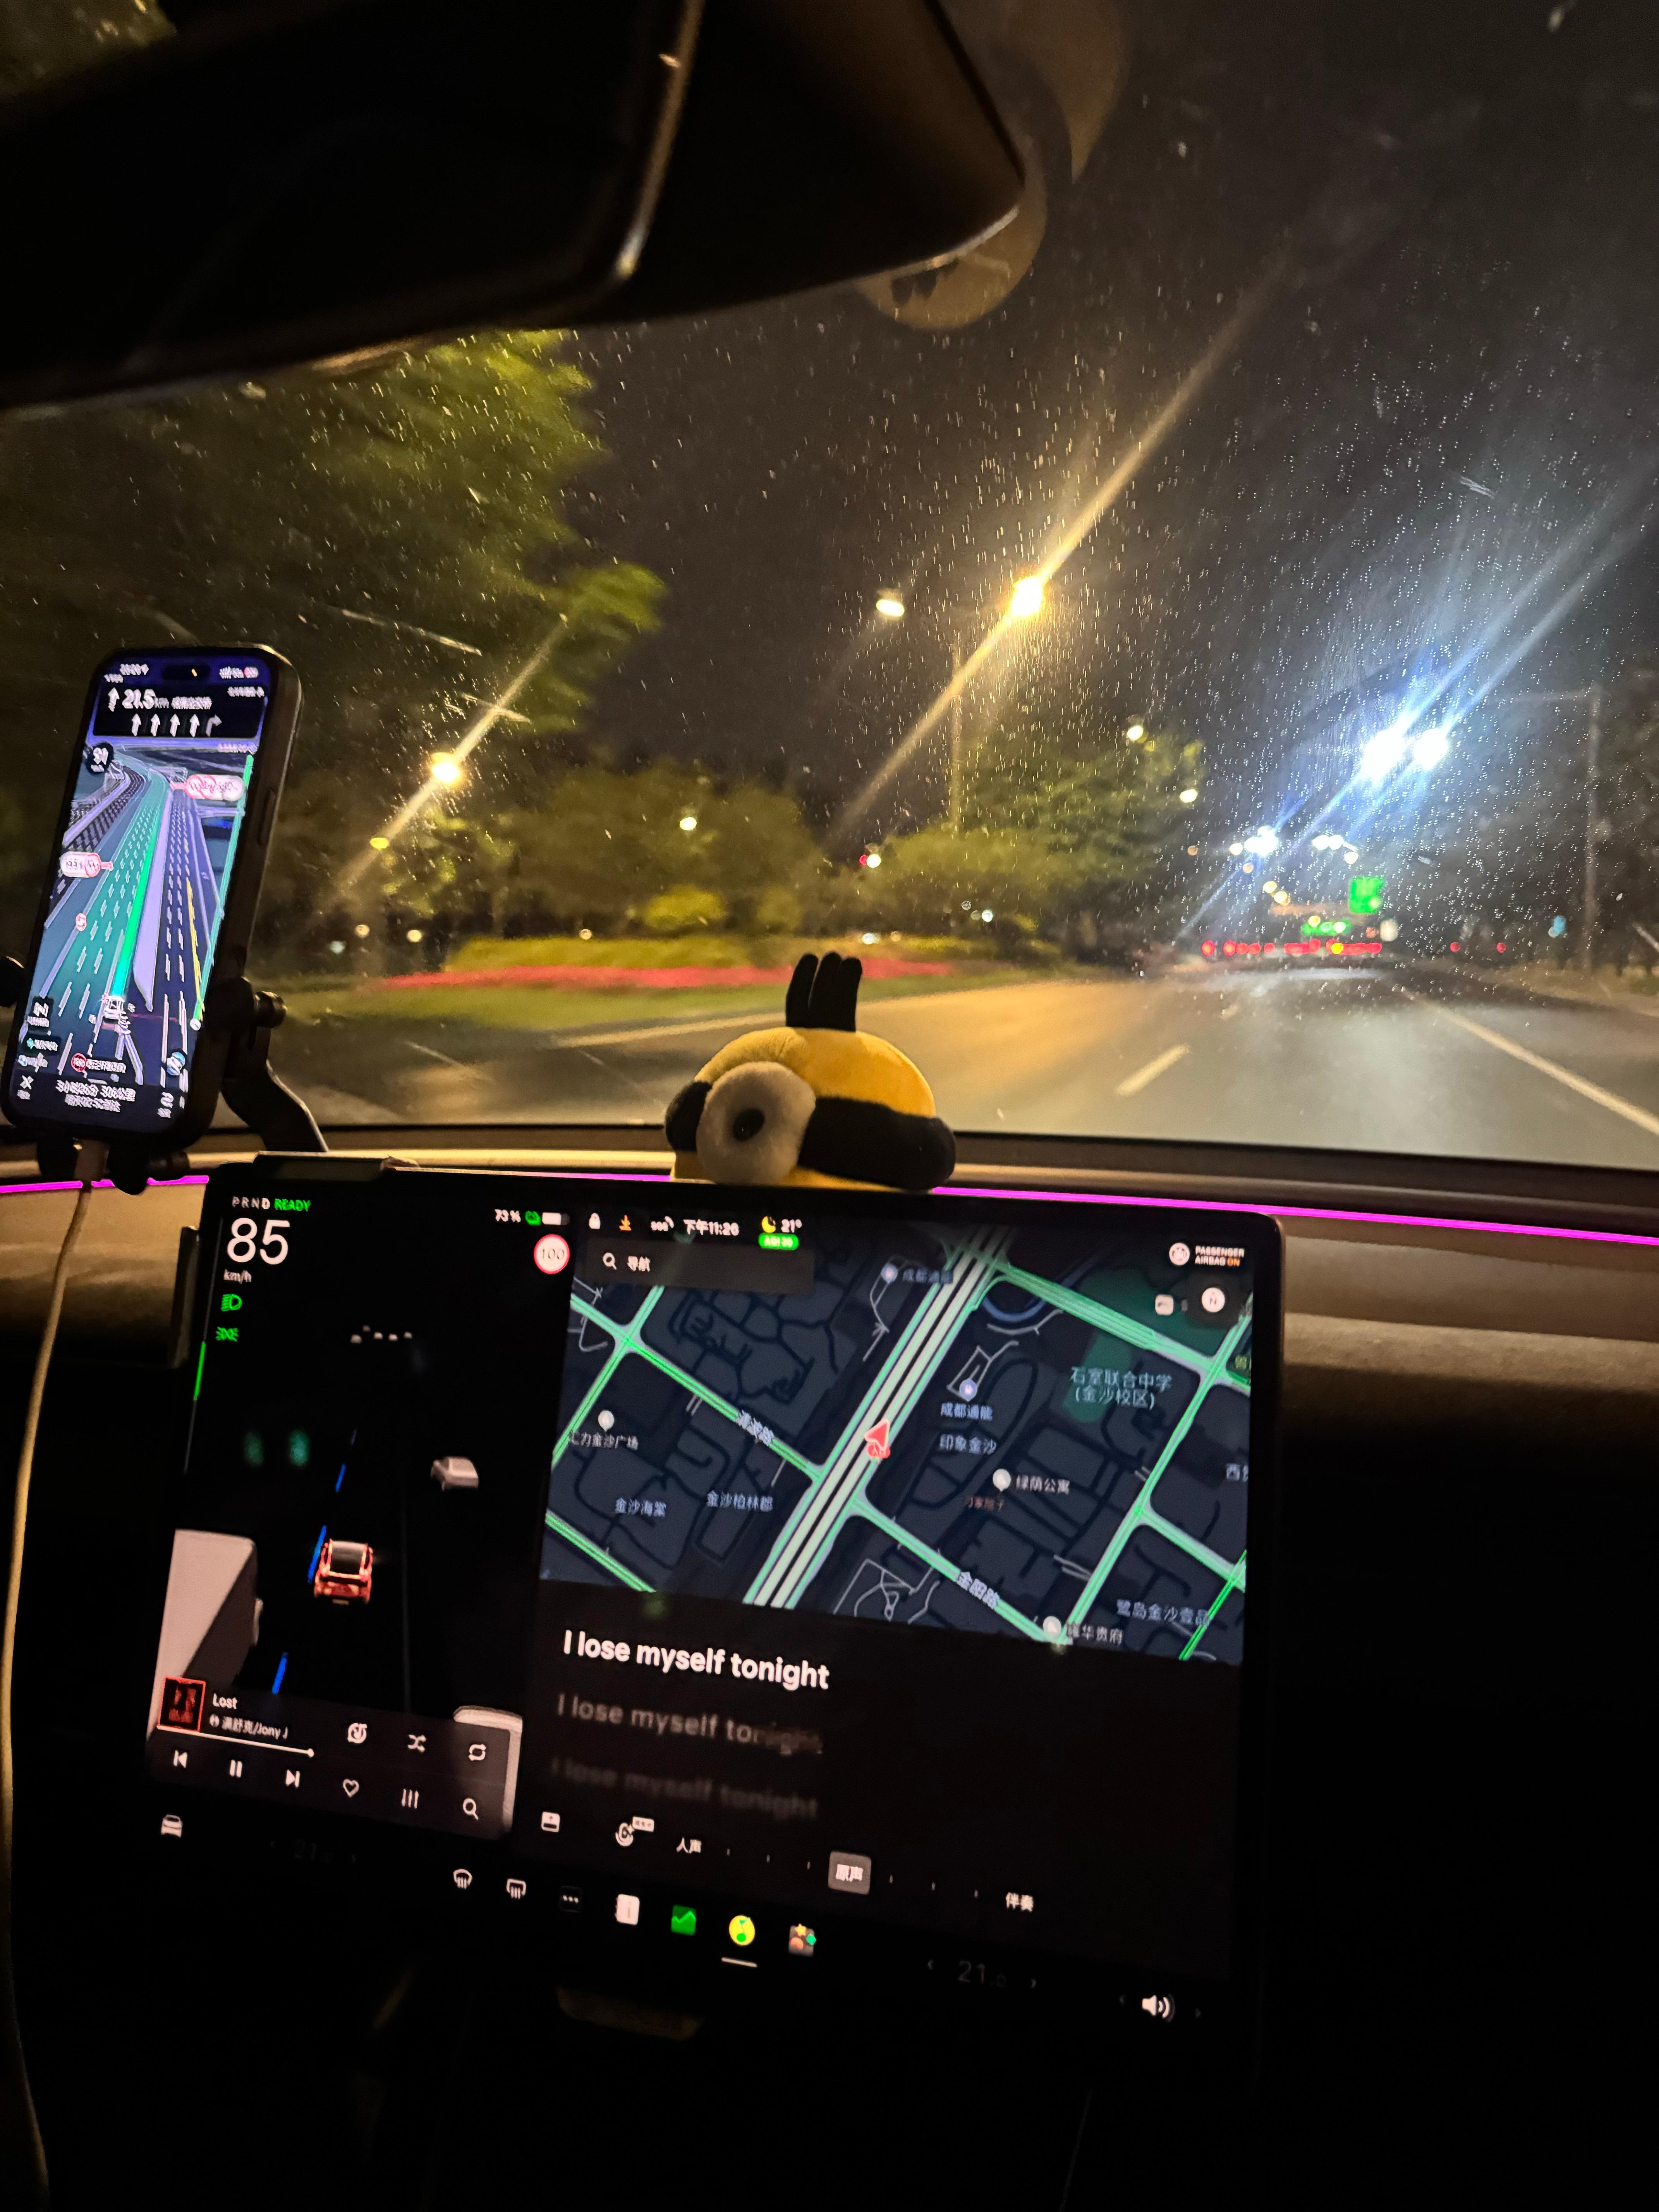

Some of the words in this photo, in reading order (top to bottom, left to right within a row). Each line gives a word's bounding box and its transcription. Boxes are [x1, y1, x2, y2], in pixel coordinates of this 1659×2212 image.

[274, 1199, 311, 1211] READY
[227, 1218, 290, 1265] 85
[543, 1249, 565, 1259] 100
[1227, 1257, 1240, 1267] ON
[627, 1256, 650, 1272] 导航
[223, 1269, 251, 1284] km/h
[564, 1630, 572, 1654] I
[578, 1631, 630, 1661] lose
[636, 1644, 725, 1674] myself
[731, 1653, 830, 1691] tonight
[213, 1693, 237, 1709] Lost
[572, 1695, 623, 1724] lose
[631, 1708, 718, 1738] myself
